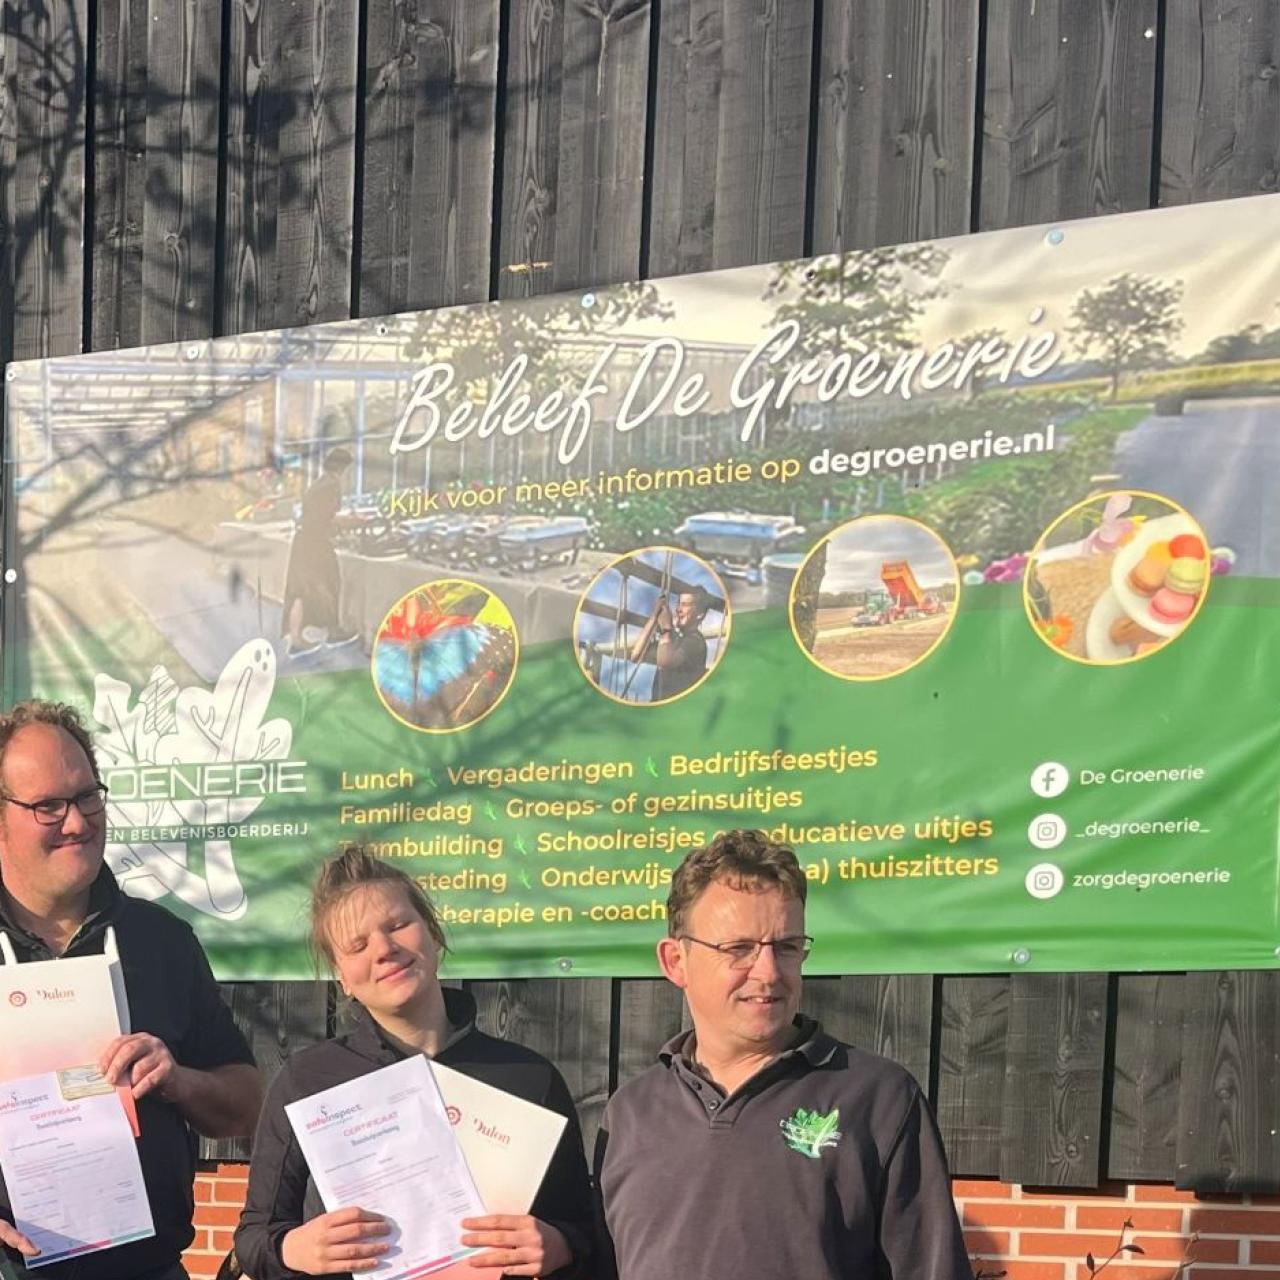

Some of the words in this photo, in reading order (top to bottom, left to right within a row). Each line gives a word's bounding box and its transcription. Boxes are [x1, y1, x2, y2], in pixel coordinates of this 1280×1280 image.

[389, 341, 618, 464] Beleef
[615, 336, 711, 432] De
[730, 306, 1061, 442] Groenerie
[387, 485, 440, 519] Kijk
[447, 486, 508, 511] voor
[516, 476, 591, 502] meer
[598, 455, 752, 495] informatie
[761, 457, 801, 485] op
[809, 424, 1056, 477] degroenerie.nl
[107, 761, 308, 800] OENERIE
[341, 768, 414, 790] Lunch
[447, 758, 633, 788] Vergaderingen
[670, 745, 878, 777] Bedrijfsfeestjes
[1080, 769, 1107, 785] De
[1111, 764, 1205, 783] Groenerie
[340, 800, 472, 824] Familiedag
[506, 798, 604, 820] Groeps-
[611, 793, 638, 814] of
[643, 786, 803, 817] gezinsuitjes
[130, 823, 308, 841] BELEVENISBOERDERIJ
[537, 827, 705, 853] Schoolreisjes
[766, 819, 905, 844] ducatieve
[914, 815, 993, 844] uitjes
[1075, 817, 1211, 839] _degroenerie_
[541, 863, 672, 889] Onderwijs
[838, 854, 999, 879] thuiszitters
[1073, 867, 1231, 889] zorgdegroenerie
[542, 905, 572, 922] en
[581, 903, 667, 921] -coach
